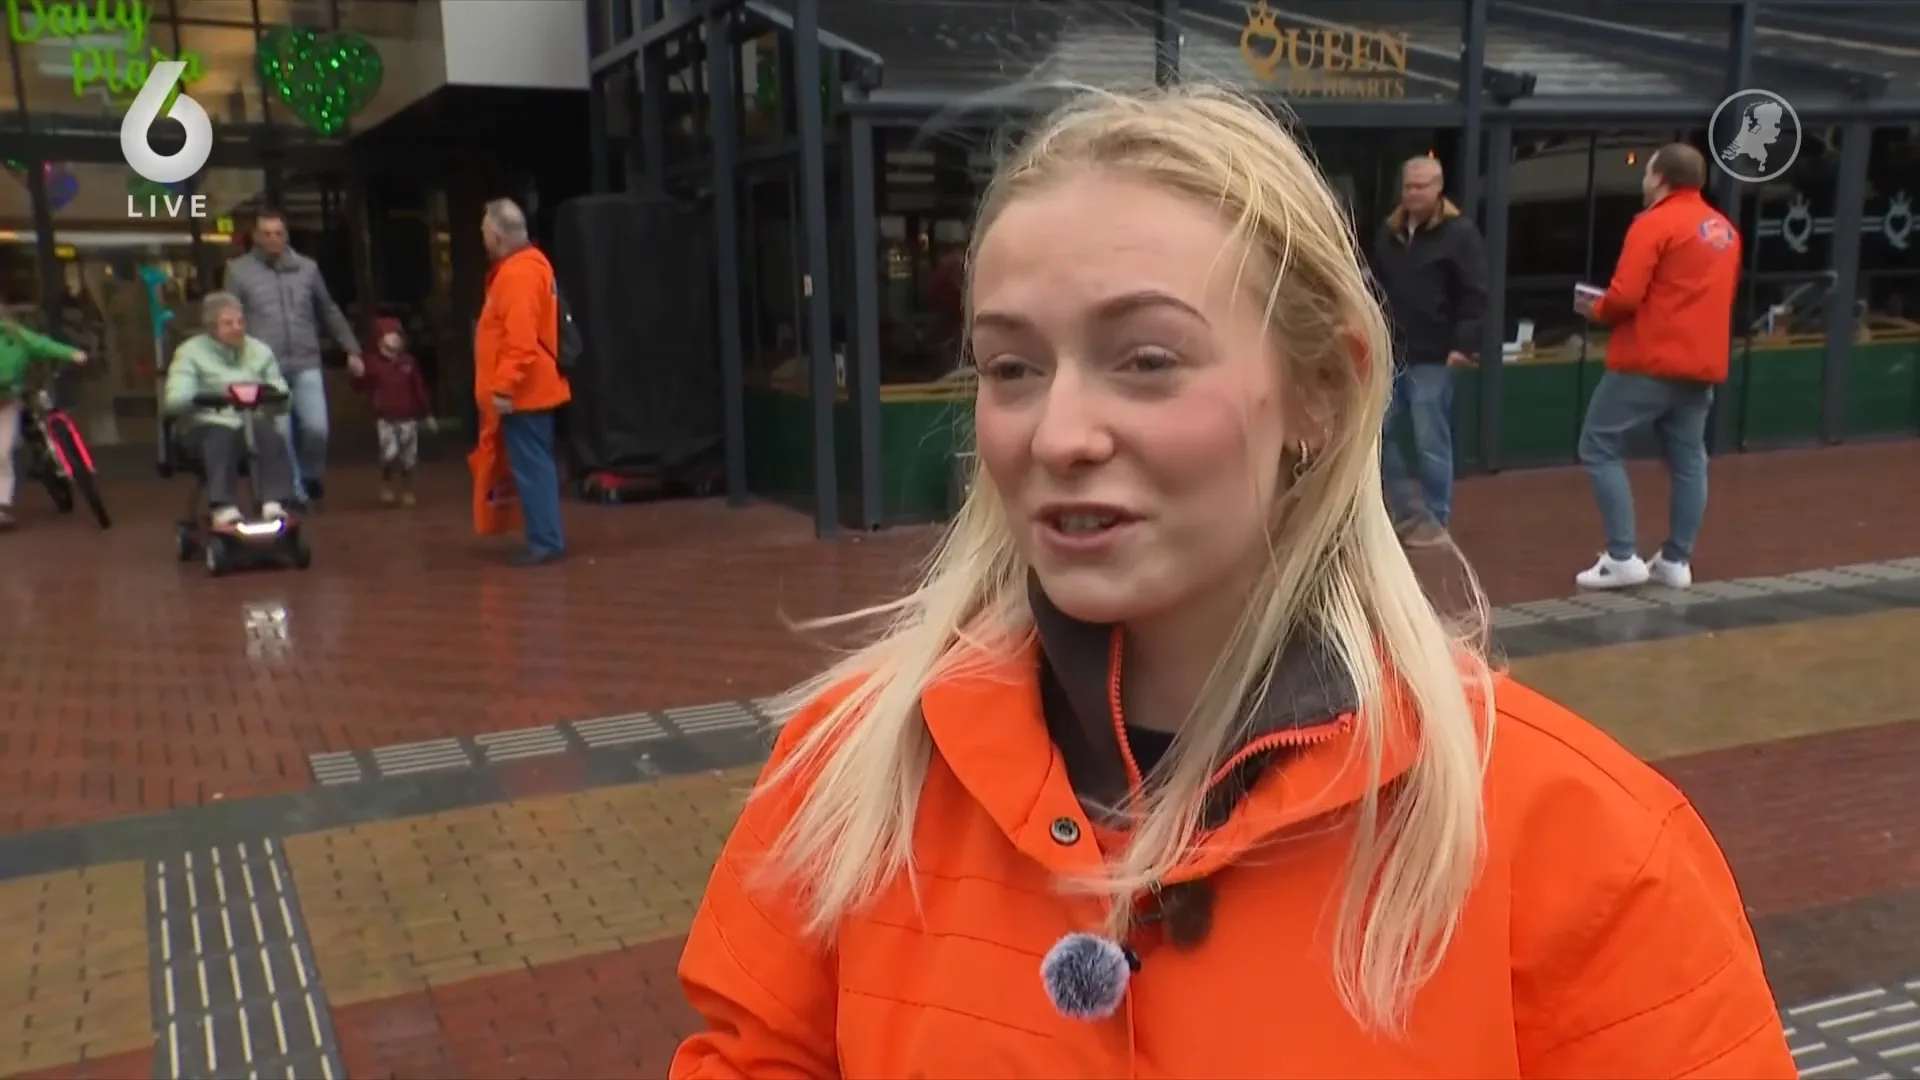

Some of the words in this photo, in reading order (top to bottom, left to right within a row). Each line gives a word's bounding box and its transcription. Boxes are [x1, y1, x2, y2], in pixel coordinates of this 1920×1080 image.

[8, 0, 147, 53] Daily
[1240, 18, 1409, 80] QUEEN
[1322, 77, 1406, 98] HEARTS
